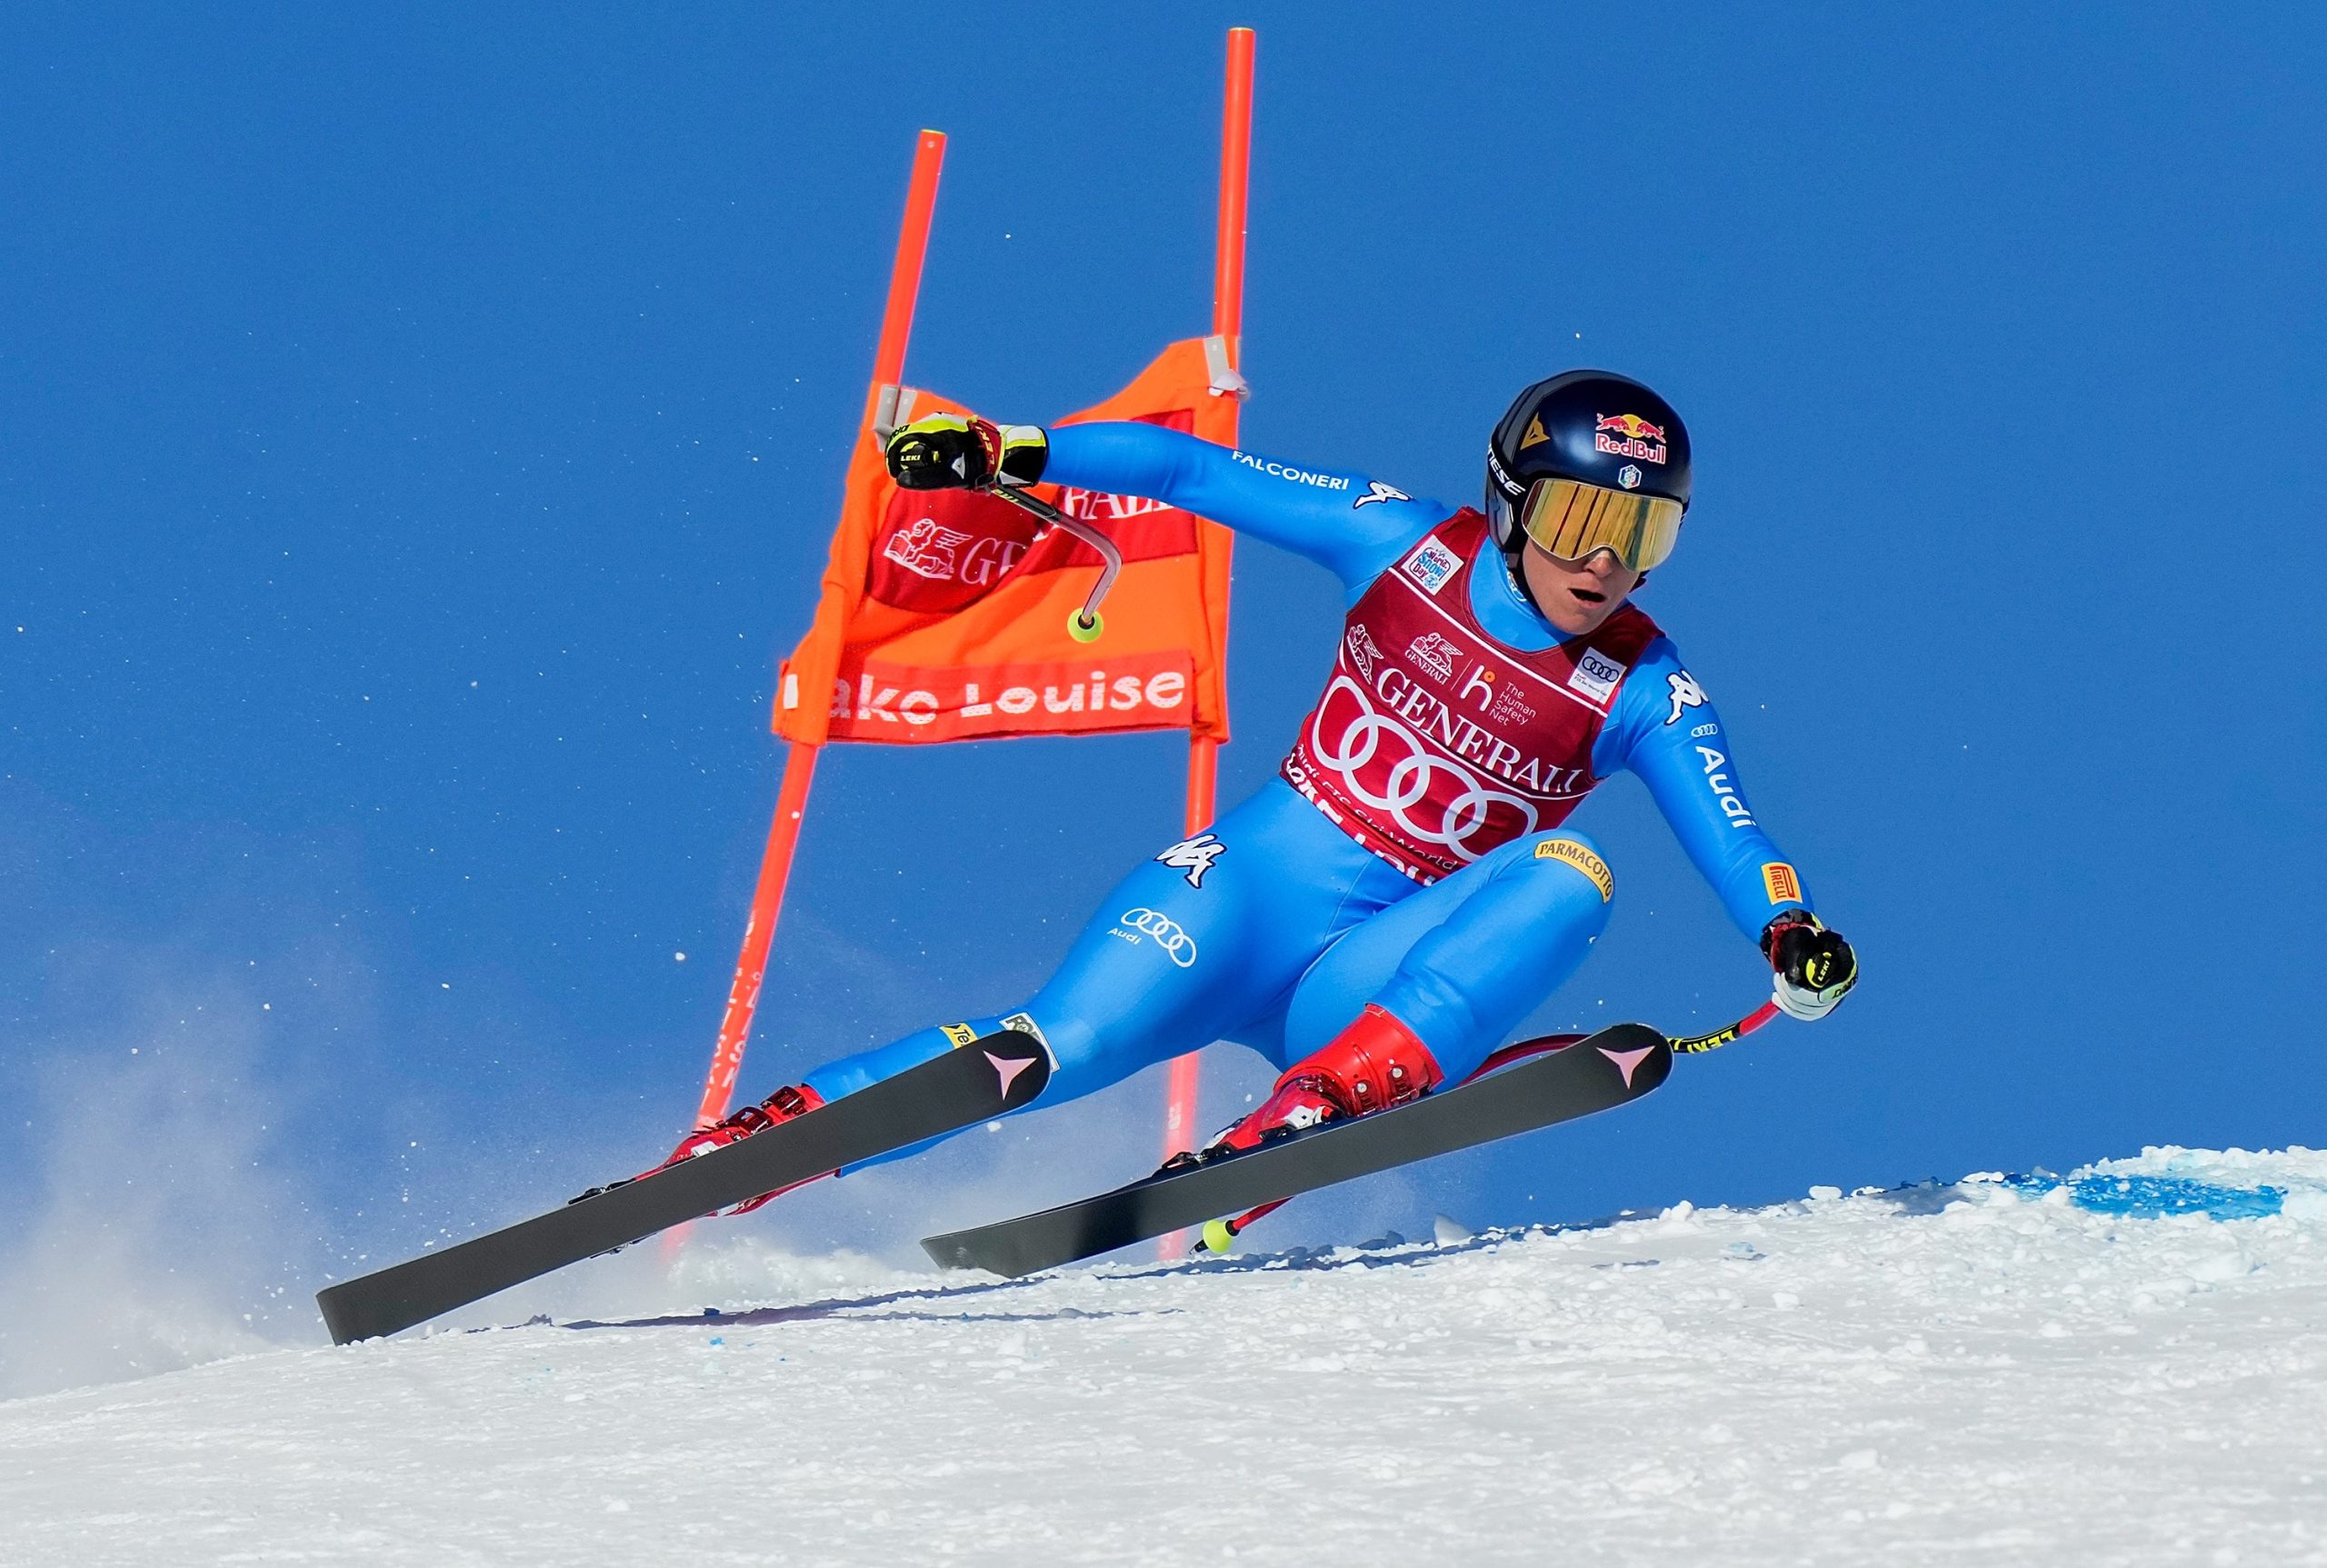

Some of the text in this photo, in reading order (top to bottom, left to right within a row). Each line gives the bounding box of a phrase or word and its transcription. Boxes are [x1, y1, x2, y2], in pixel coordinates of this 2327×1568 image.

[1595, 434, 1666, 464] Red Bull
[1232, 451, 1350, 490] FALCONERI
[1487, 444, 1526, 495] NESE
[1413, 564, 1428, 578] Day
[1404, 649, 1448, 685] GENERALI
[830, 671, 1185, 725] ake Louise
[1500, 691, 1536, 718] Human
[1506, 682, 1524, 699] The
[1489, 709, 1509, 726] Net
[1494, 701, 1528, 725] Safety
[1377, 667, 1584, 793] GENERALI
[1695, 745, 1756, 828] Audi
[1540, 843, 1613, 897] PARMACOTTO
[1769, 865, 1796, 899] PIRELLI
[1106, 927, 1142, 945] Audi
[1818, 960, 1830, 982] LEKI
